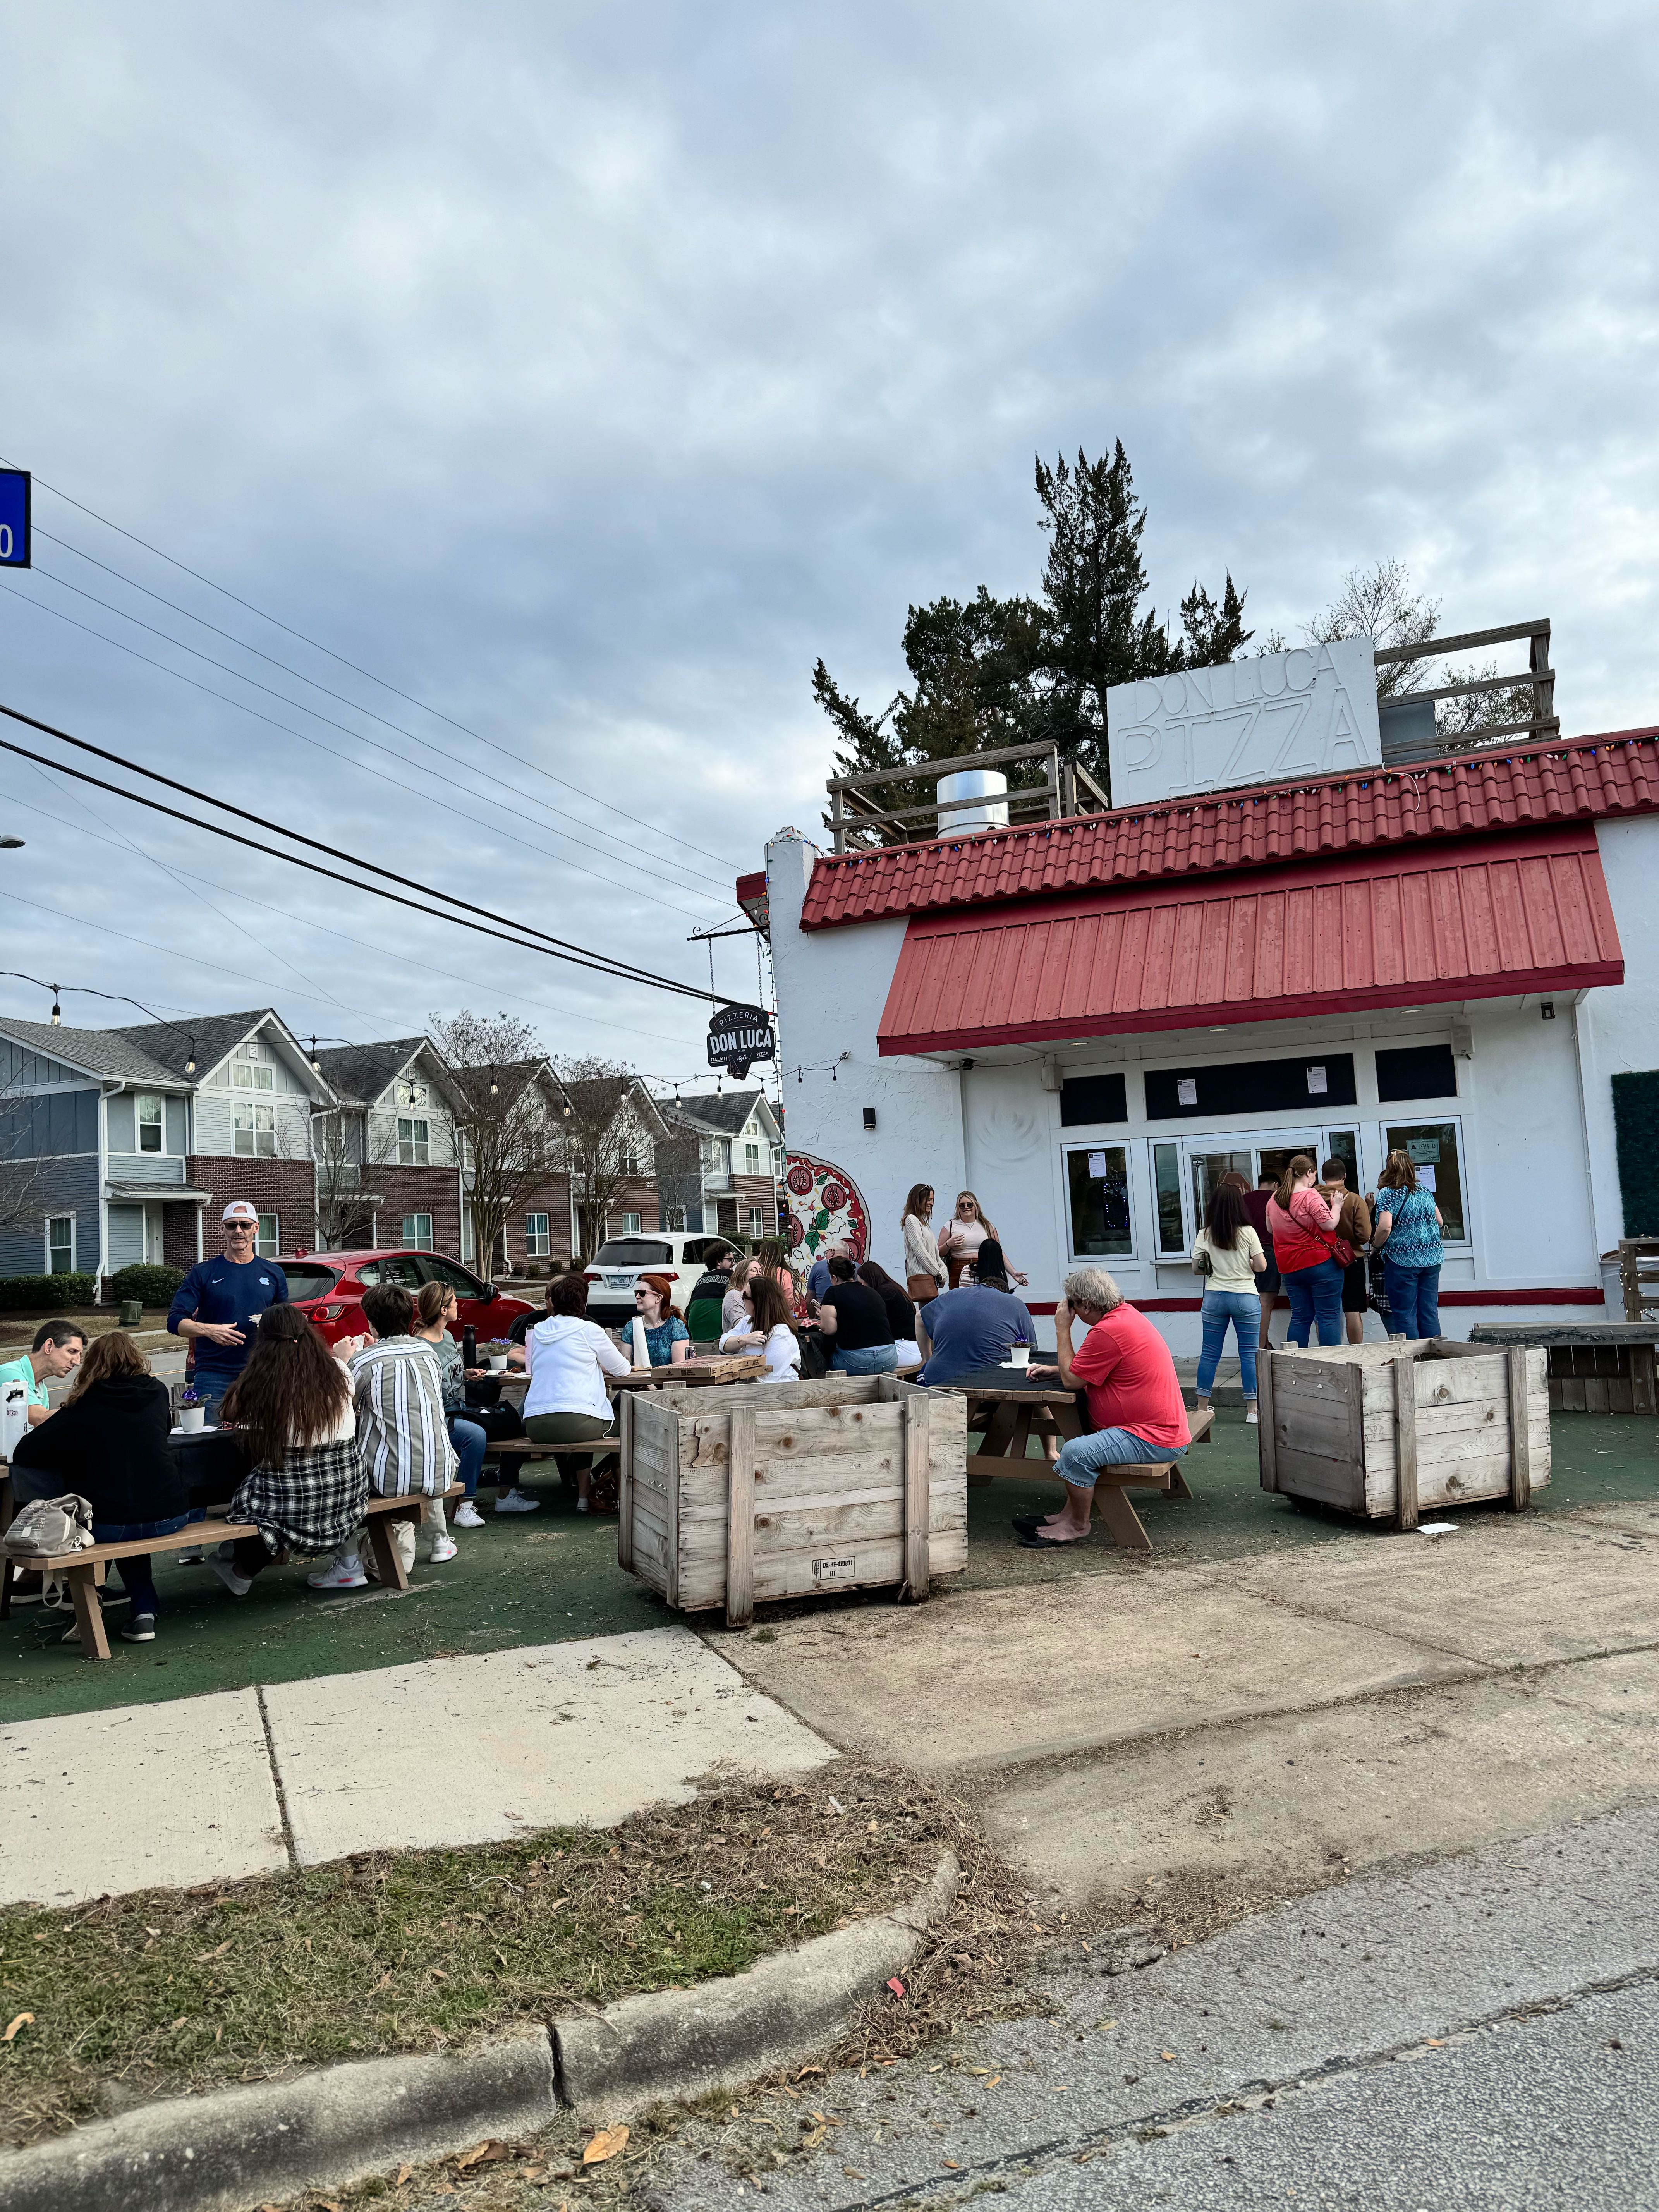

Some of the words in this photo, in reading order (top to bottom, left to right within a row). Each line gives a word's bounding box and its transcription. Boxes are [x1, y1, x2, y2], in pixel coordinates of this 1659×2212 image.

[1136, 666, 1213, 722] DON
[1234, 644, 1342, 703] LUCA
[1118, 687, 1370, 805] PIZZA
[710, 1031, 737, 1054] DON
[740, 1029, 772, 1049] LUCA
[719, 1012, 757, 1026] PIZZERIA
